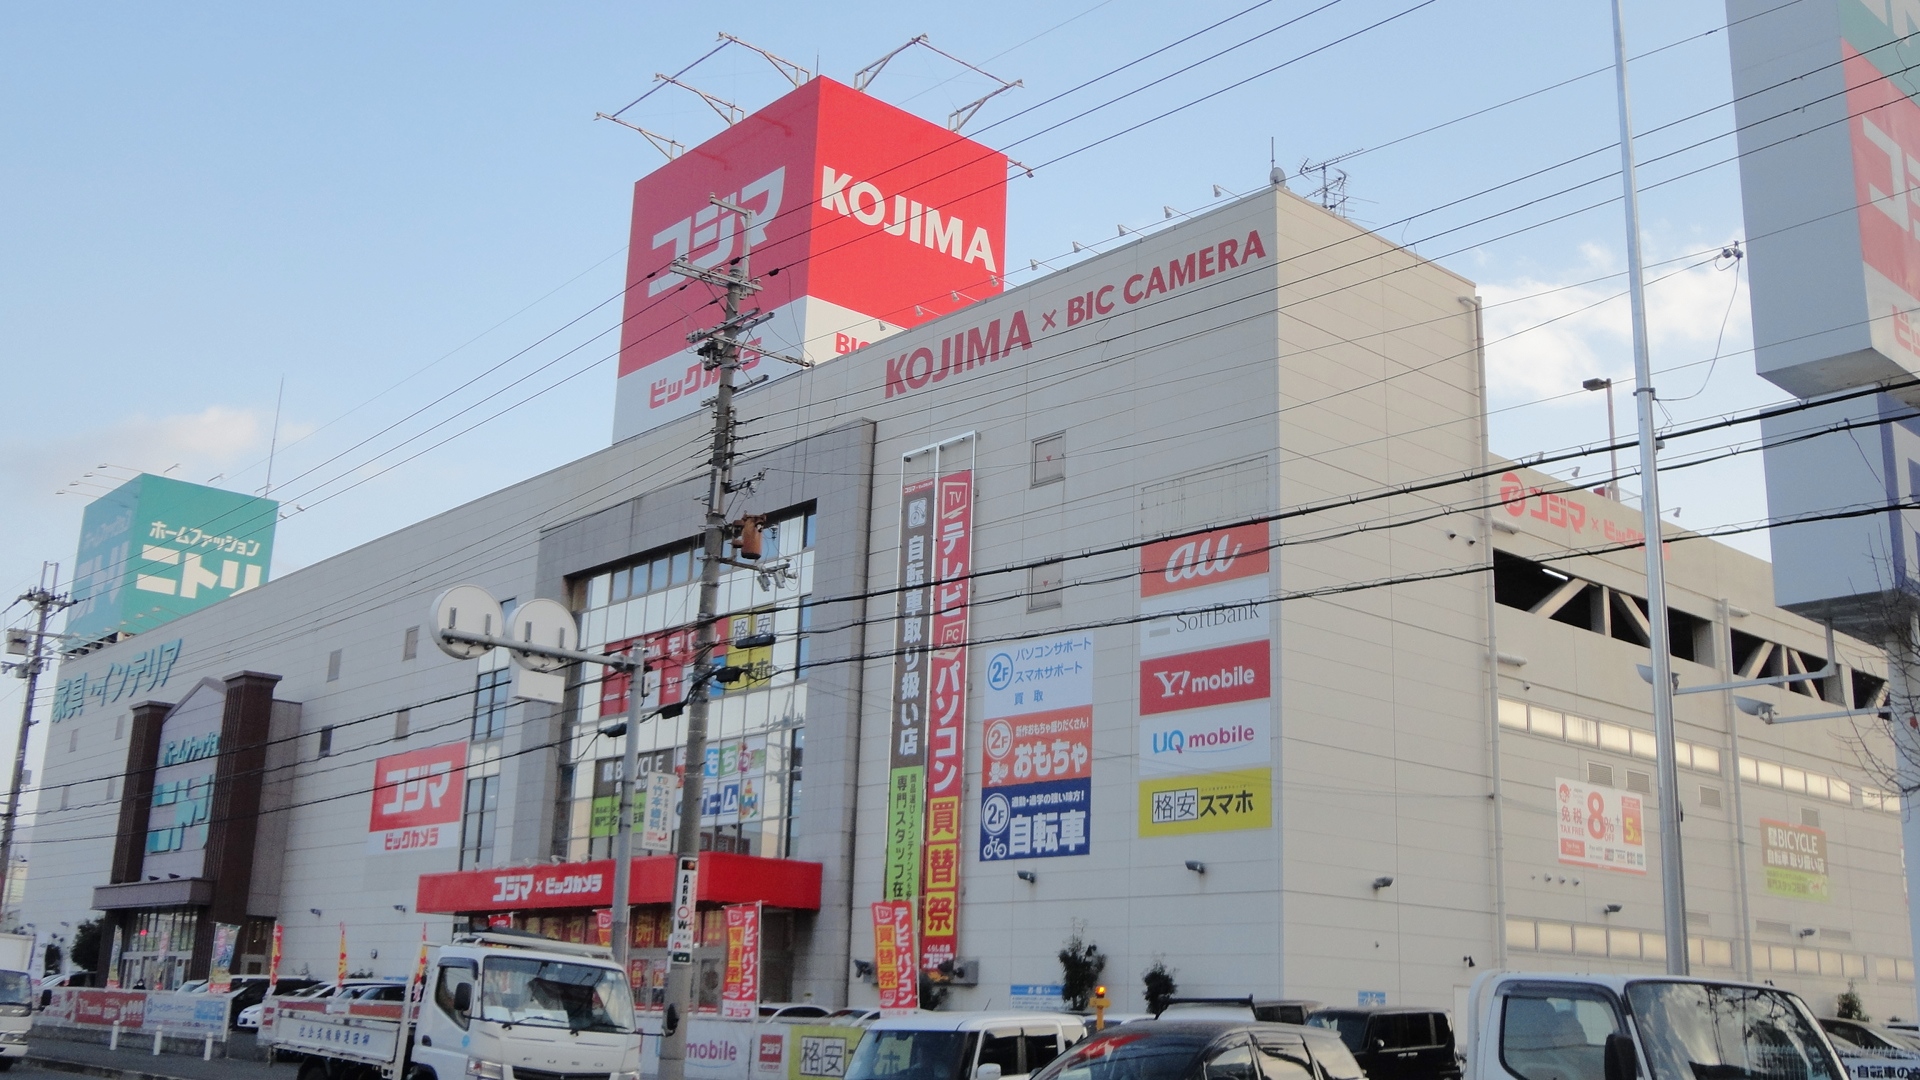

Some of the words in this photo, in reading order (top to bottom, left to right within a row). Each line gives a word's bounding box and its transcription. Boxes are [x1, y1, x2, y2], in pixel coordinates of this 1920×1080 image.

[648, 165, 786, 298] コジマ
[821, 165, 997, 273] KOJIMA
[885, 310, 1032, 400] KOJIMA
[1066, 285, 1115, 327] BIC
[1123, 230, 1267, 305] CAMERA
[949, 491, 963, 506] TV
[149, 520, 260, 557] ホームファッション
[136, 544, 262, 600] ニトリ
[940, 521, 965, 617] テレビ
[1165, 534, 1242, 583] au
[945, 628, 960, 641] PC
[1176, 599, 1260, 633] SoftBank
[898, 535, 925, 757] 自転車取り扱い店
[1015, 637, 1092, 662] パソコンサポート
[992, 662, 1009, 683] 2F
[1015, 661, 1083, 684] スマホサポート
[1154, 665, 1255, 698] Y!mobile
[934, 661, 961, 792] パソコン
[990, 729, 1011, 750] 2F
[1153, 730, 1184, 754] UQ
[1188, 725, 1255, 748] mobile
[1013, 738, 1088, 779] おもちゃ
[382, 761, 452, 816] コジマ
[1154, 790, 1254, 821] 格安スマホ
[987, 803, 1004, 826] 2F
[1009, 809, 1086, 855] 自転車
[384, 827, 439, 851] ビックカメラ
[892, 775, 908, 901] 専門スタッフ在
[1778, 828, 1819, 854] BICYCLE
[928, 801, 955, 932] 買替祭
[894, 907, 913, 1005] テレビ・パソコン
